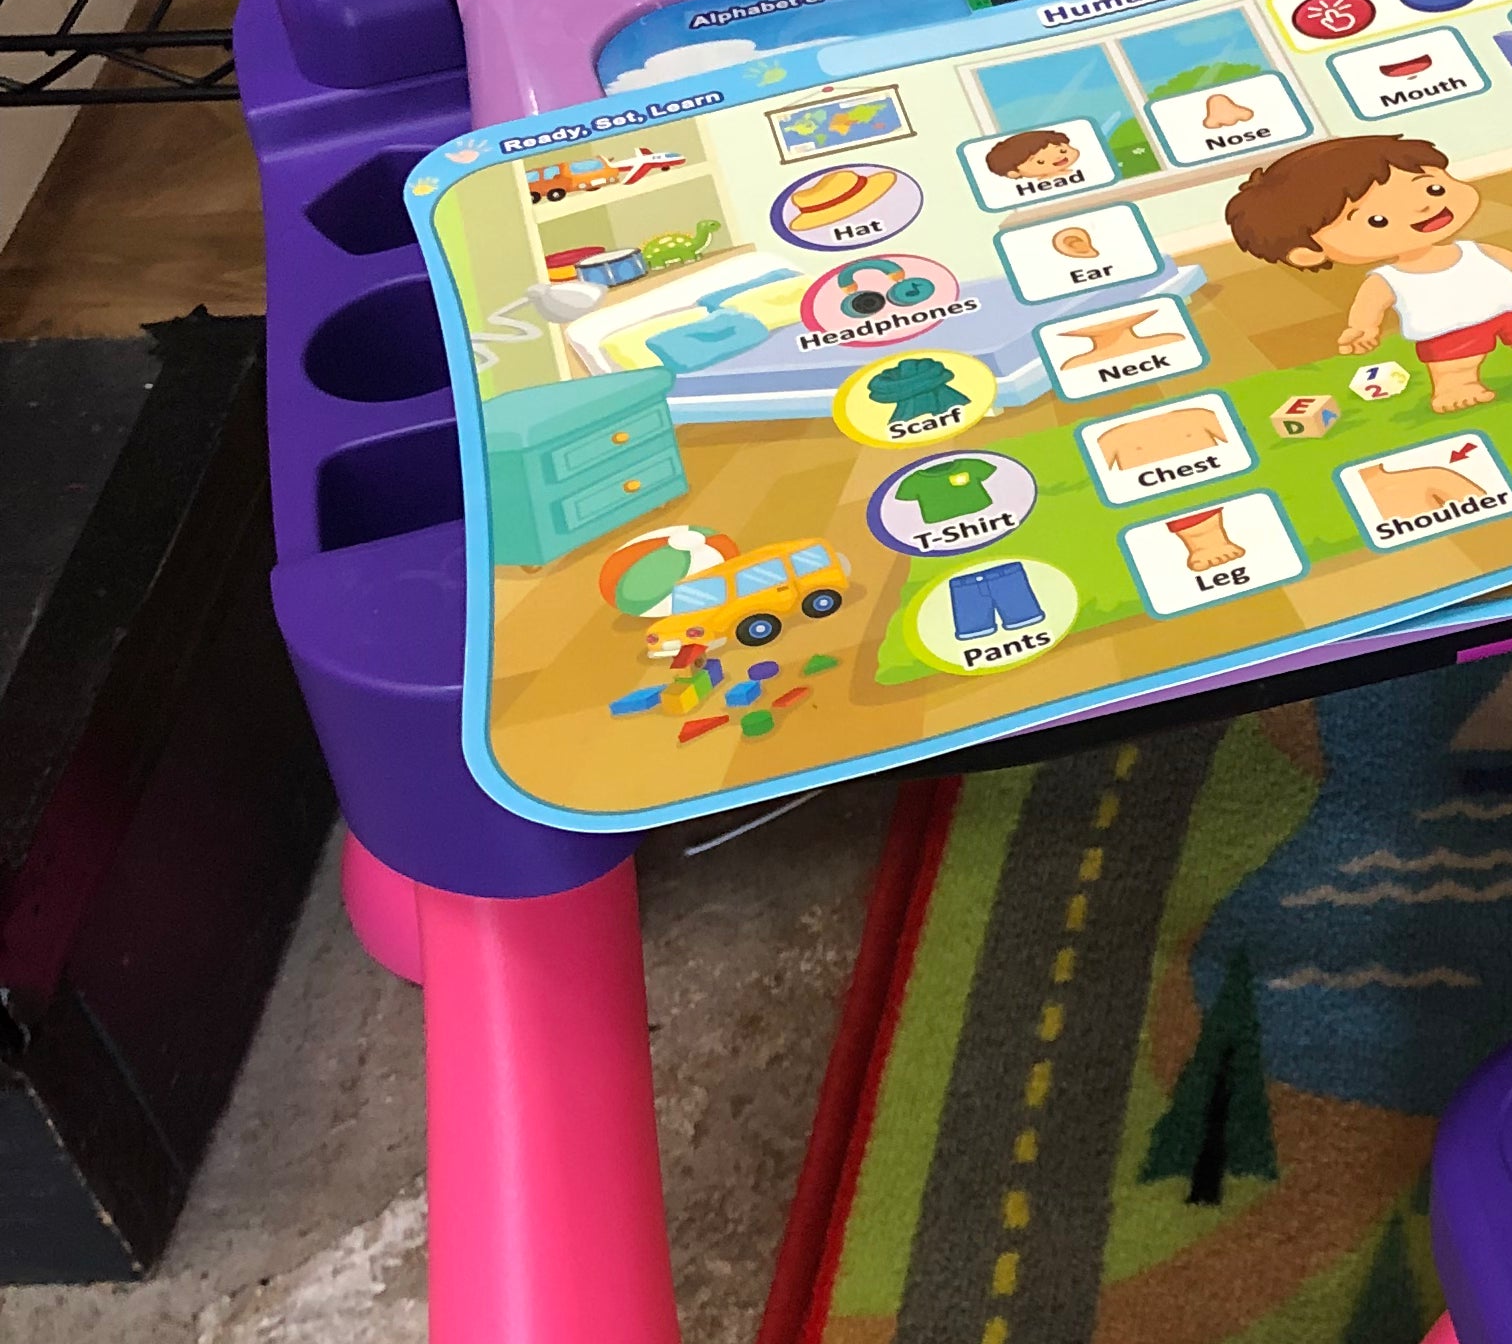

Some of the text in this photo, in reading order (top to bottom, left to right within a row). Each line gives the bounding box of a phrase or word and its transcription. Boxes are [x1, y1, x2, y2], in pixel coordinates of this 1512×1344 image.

[1380, 76, 1467, 108] Mouth
[502, 90, 723, 154] Ready, Set, Learn
[1206, 124, 1272, 151] Nose
[1015, 170, 1085, 197] Head
[833, 218, 884, 241] Hat
[1070, 262, 1114, 285] Ear
[799, 298, 978, 348] Headphones
[1098, 353, 1171, 383] Neck
[889, 408, 964, 440] Scarf
[1138, 453, 1222, 487] Chest
[913, 511, 1016, 550] T-Shirt
[1376, 490, 1509, 540] Shoulder
[1195, 566, 1250, 592] Leg
[963, 630, 1051, 668] Pants
